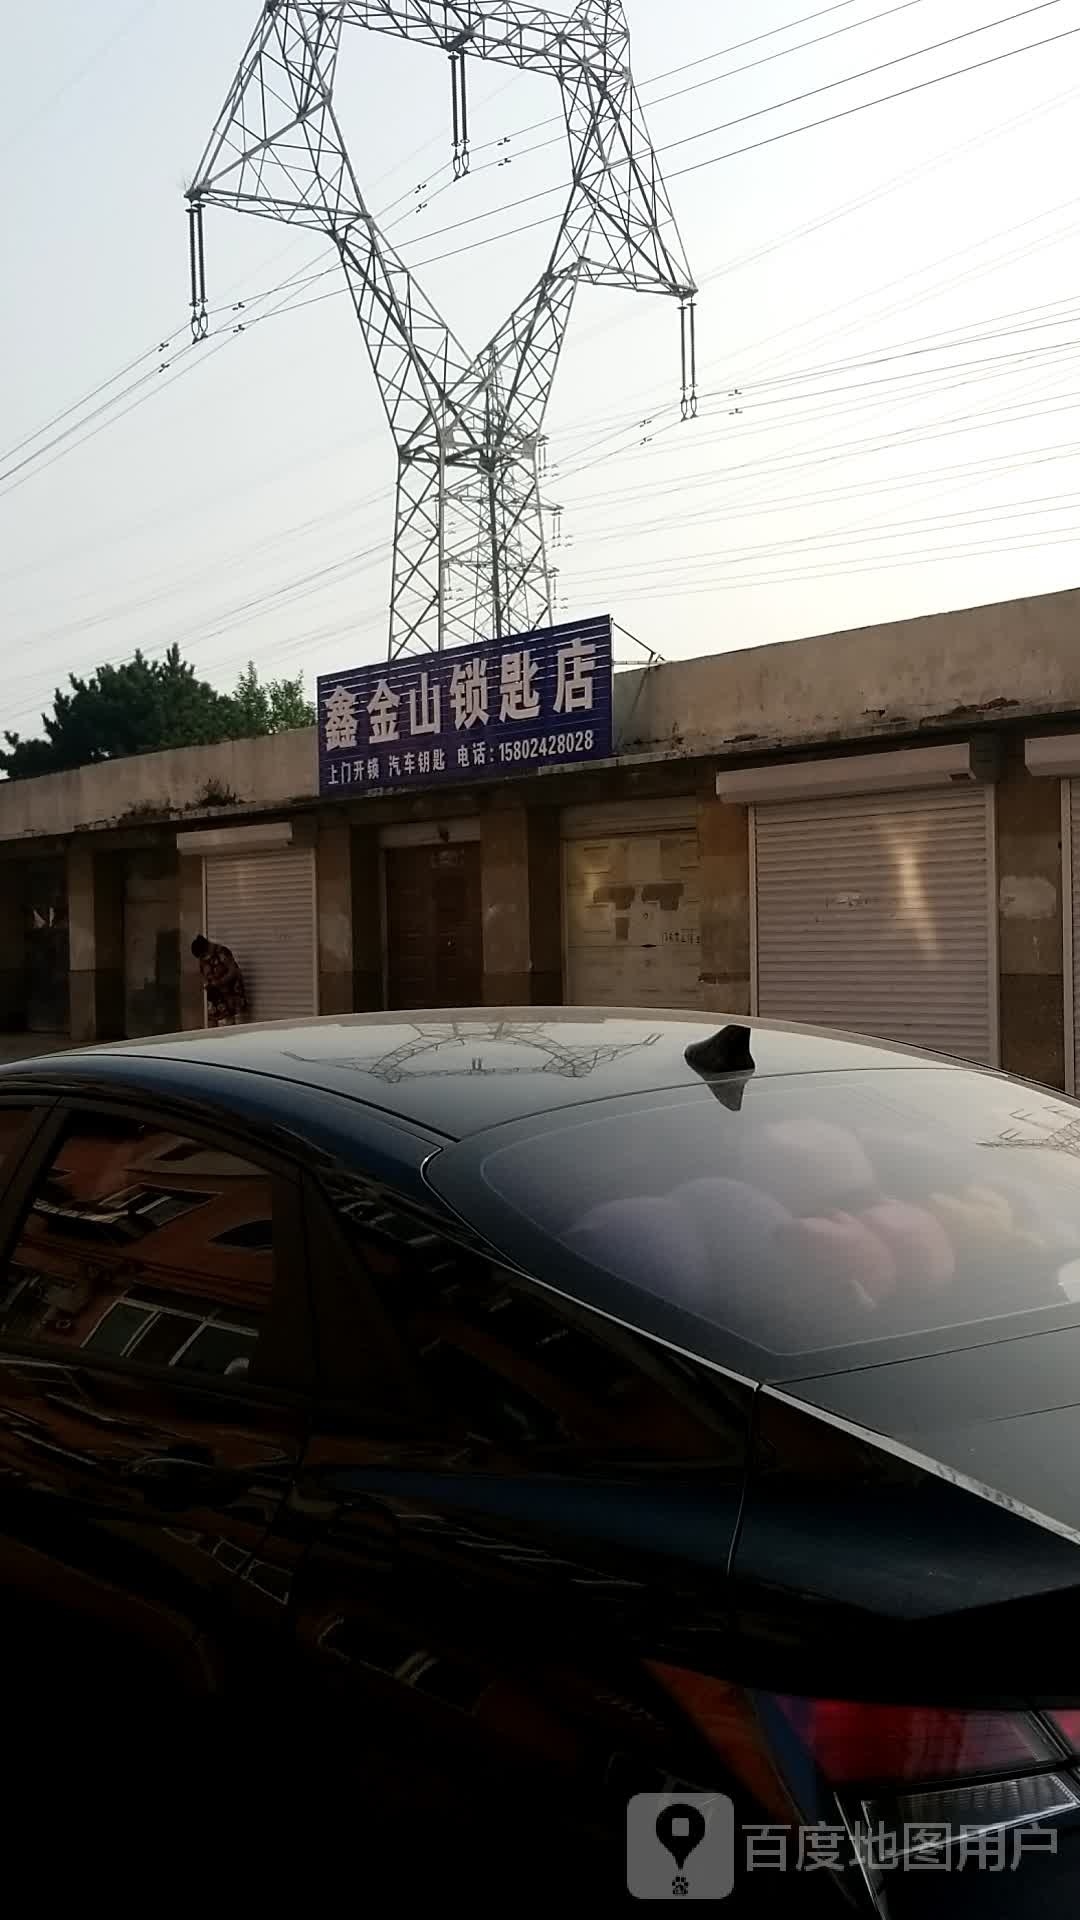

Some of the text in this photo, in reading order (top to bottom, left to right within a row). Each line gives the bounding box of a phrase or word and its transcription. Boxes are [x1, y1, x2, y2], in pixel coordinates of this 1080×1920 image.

[324, 638, 597, 751] 鑫金山锁匙店
[328, 757, 380, 785] 上门开锁
[388, 748, 446, 777] 汽车钥匙
